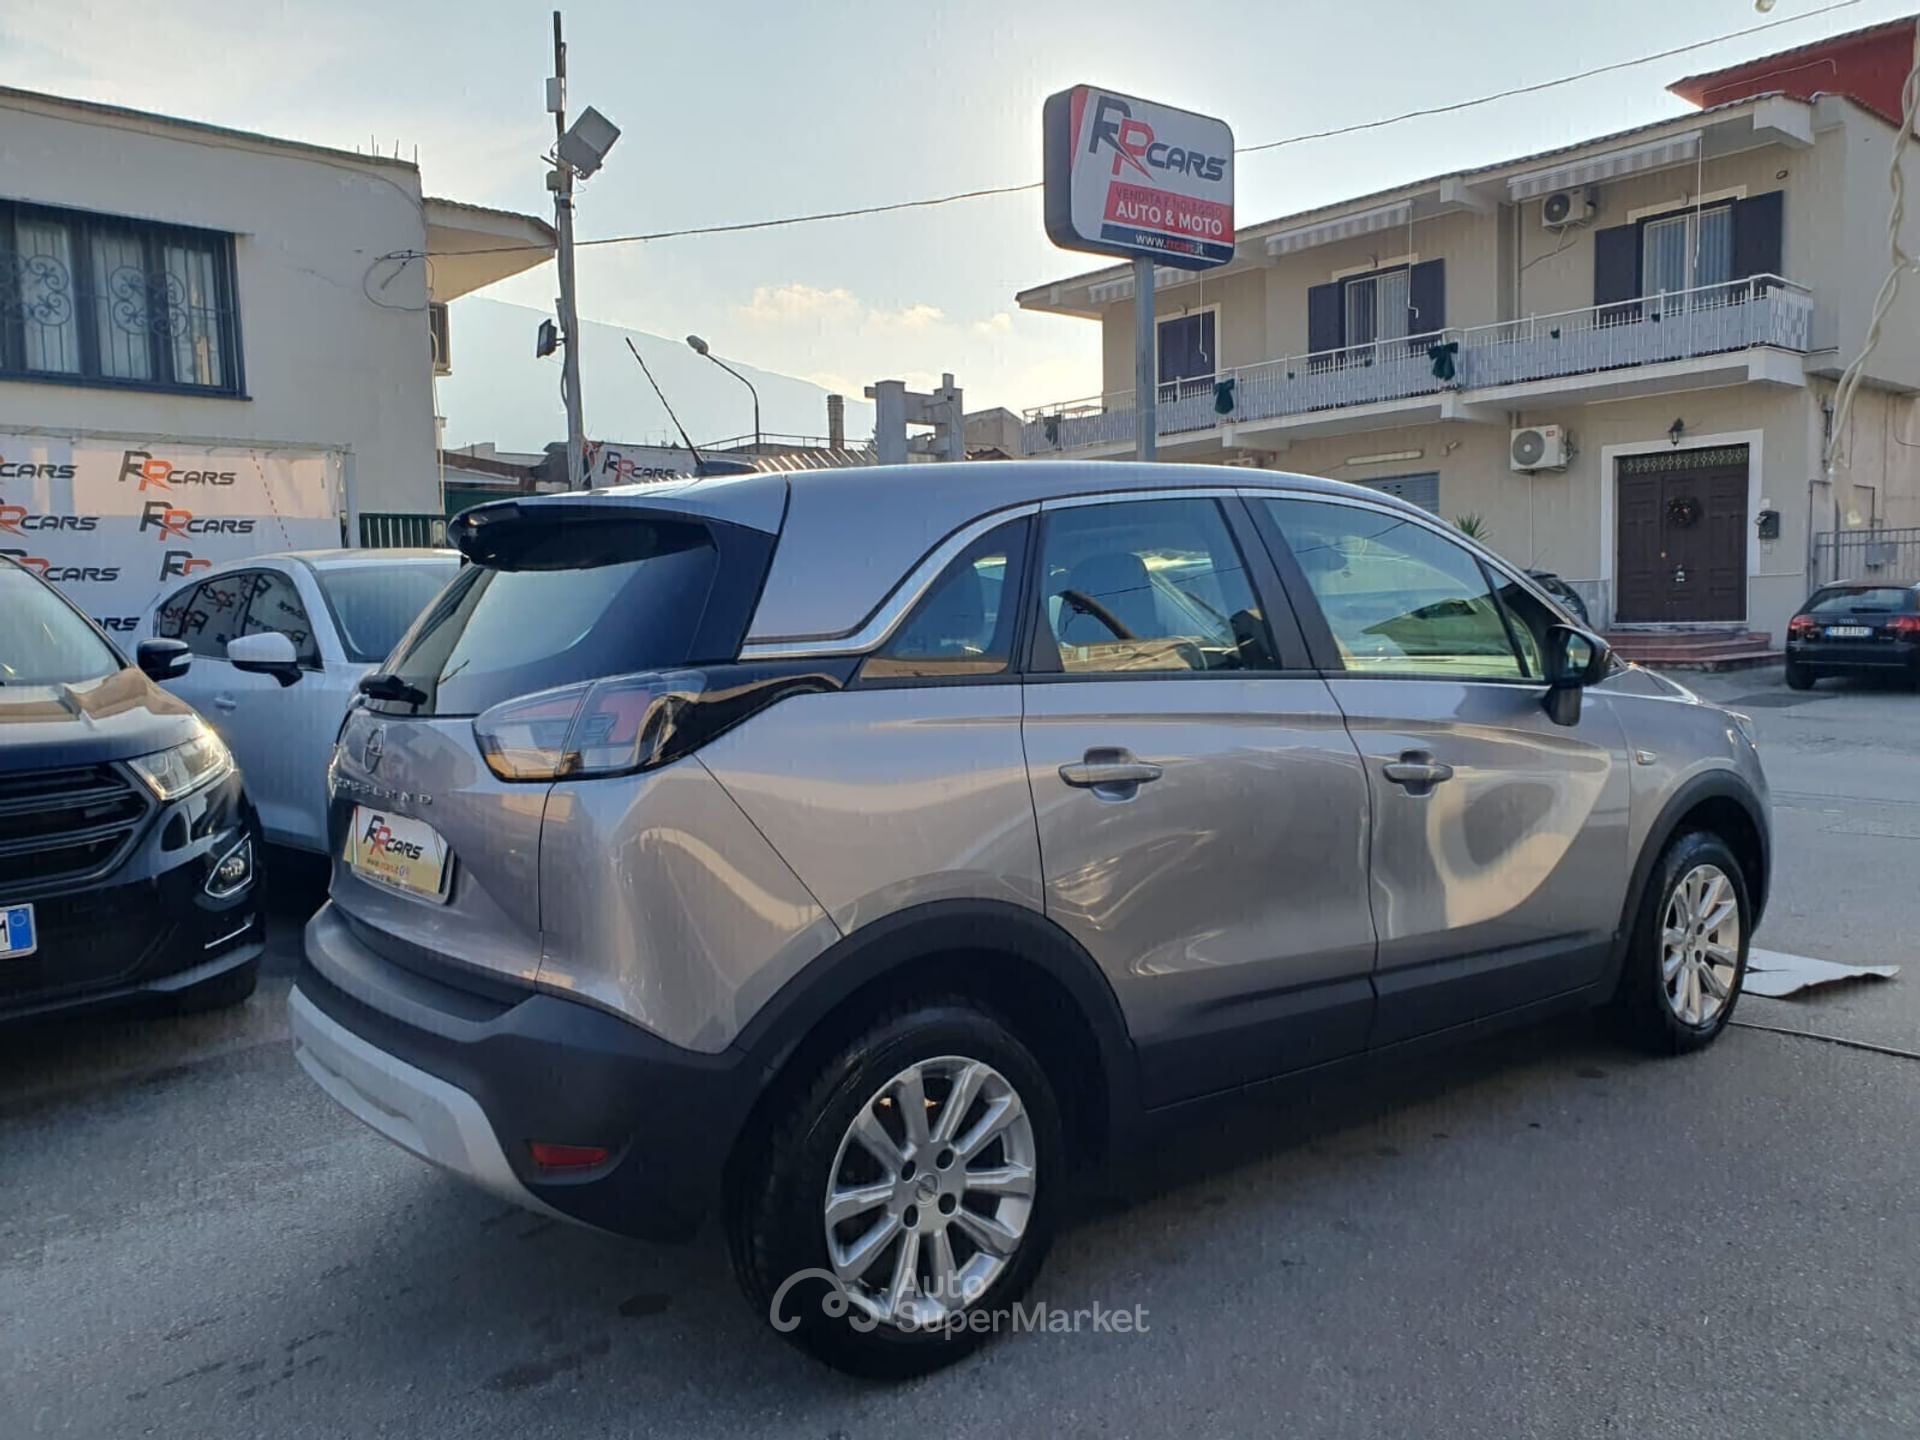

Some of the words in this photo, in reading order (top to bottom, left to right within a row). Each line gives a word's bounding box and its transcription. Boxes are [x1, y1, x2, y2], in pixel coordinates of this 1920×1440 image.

[1116, 186, 1161, 206] VENDITA
[1115, 200, 1161, 223] AUTO
[1165, 209, 1176, 227] &
[1179, 212, 1223, 236] MOTO
